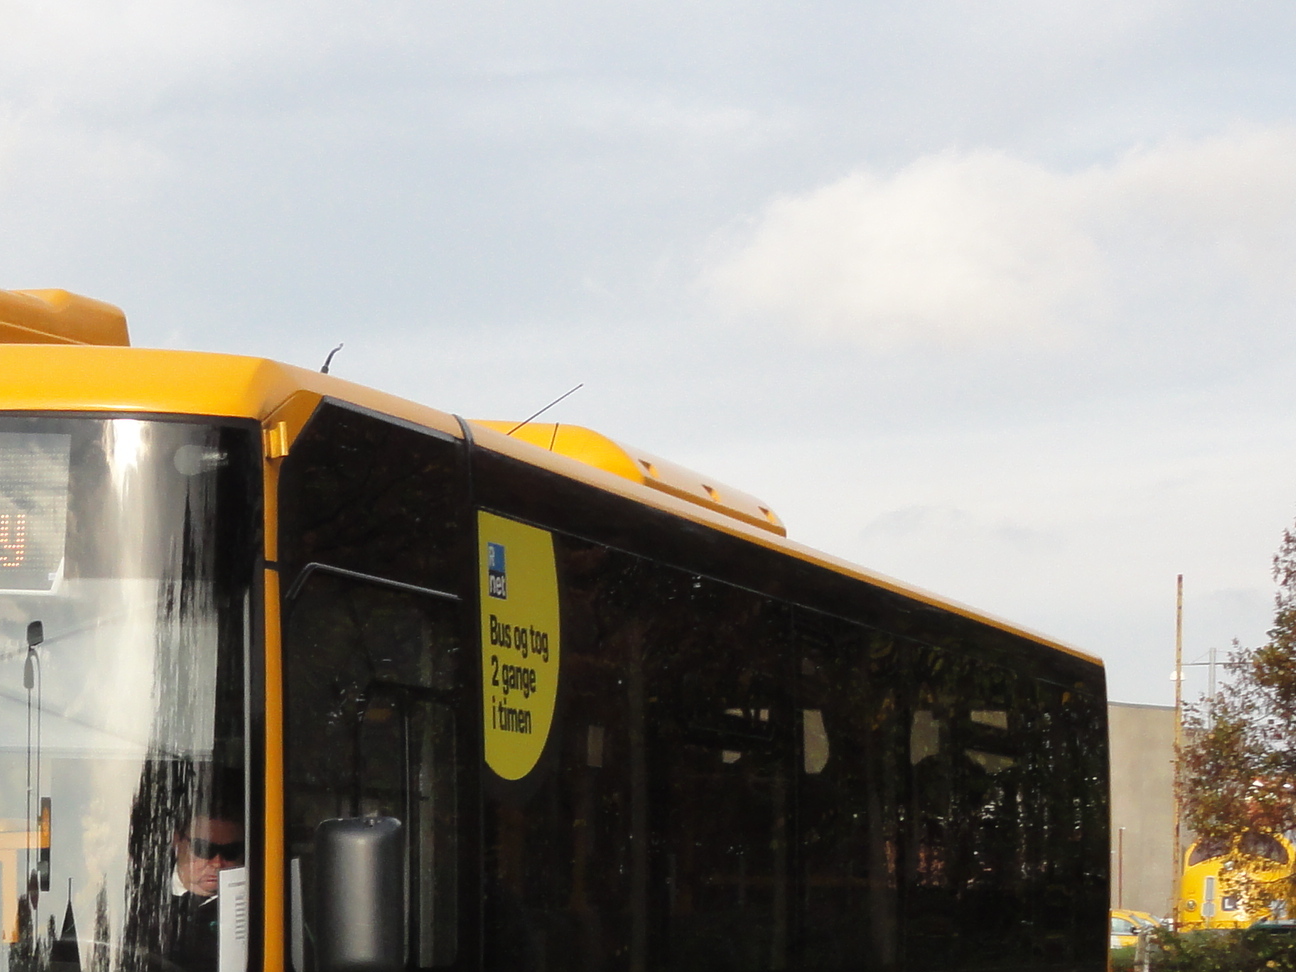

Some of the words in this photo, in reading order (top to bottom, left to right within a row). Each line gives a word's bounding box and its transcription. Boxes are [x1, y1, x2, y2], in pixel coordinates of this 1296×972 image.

[489, 613, 512, 649] Bus
[514, 626, 528, 659] og
[530, 624, 549, 664] tog
[491, 655, 499, 687] 2
[502, 664, 536, 699] gange
[498, 697, 532, 735] timen
